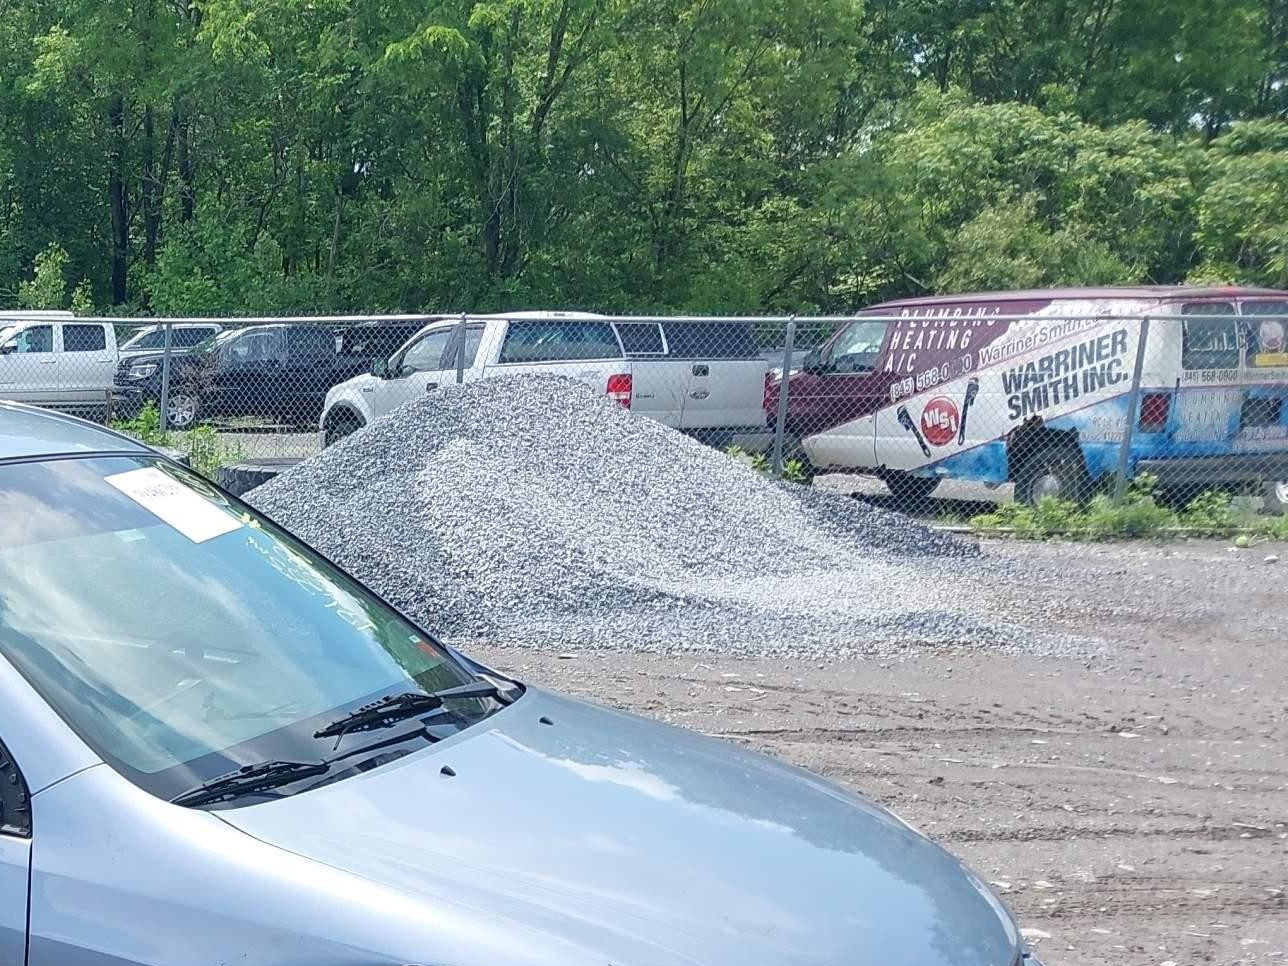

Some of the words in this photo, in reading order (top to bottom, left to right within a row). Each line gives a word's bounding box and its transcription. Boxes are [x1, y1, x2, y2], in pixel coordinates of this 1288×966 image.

[897, 307, 1000, 328] PLUMBING
[889, 329, 972, 350] HEATING
[884, 353, 917, 373] A/C
[890, 378, 914, 402] (845)
[916, 354, 973, 391] 568-00
[1001, 327, 1128, 395] WARRINER
[1007, 373, 1079, 420] SMITH
[1082, 358, 1129, 395] INC.
